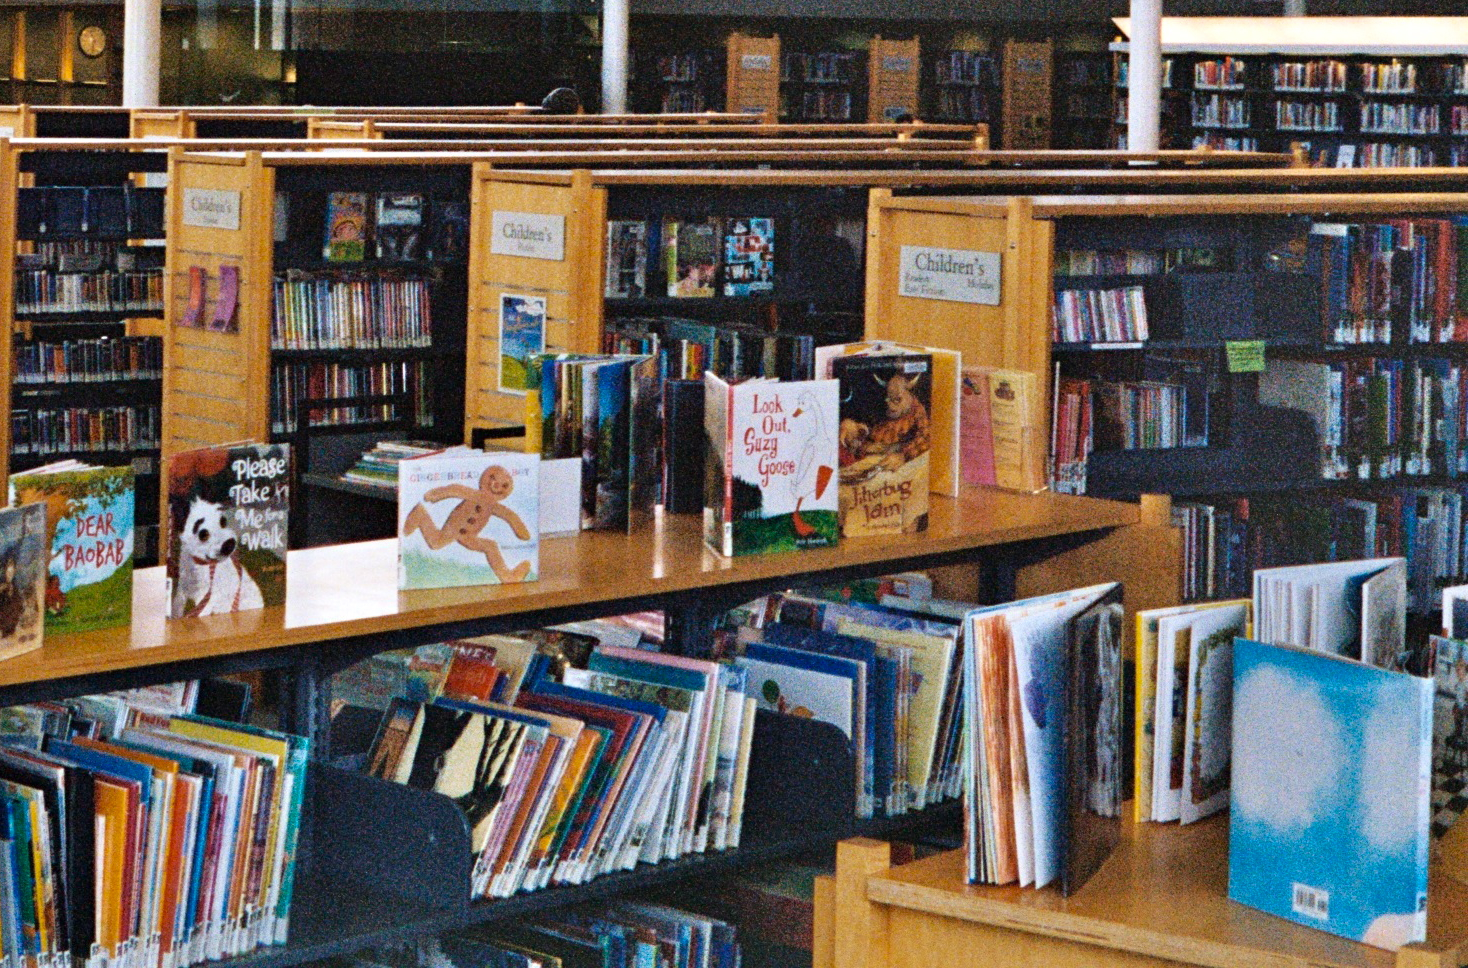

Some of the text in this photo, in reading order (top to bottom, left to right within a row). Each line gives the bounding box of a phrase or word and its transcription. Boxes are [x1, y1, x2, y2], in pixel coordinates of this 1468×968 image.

[502, 222, 552, 243] Children's
[915, 252, 985, 276] Children's
[753, 393, 784, 414] Look
[743, 427, 778, 459] Suzy
[231, 457, 287, 481] Please
[757, 453, 796, 488] Goose
[228, 480, 270, 505] Take
[234, 508, 264, 529] Me
[863, 502, 901, 523] Jam
[76, 512, 117, 538] DEAR
[63, 538, 125, 571] BAOBAB
